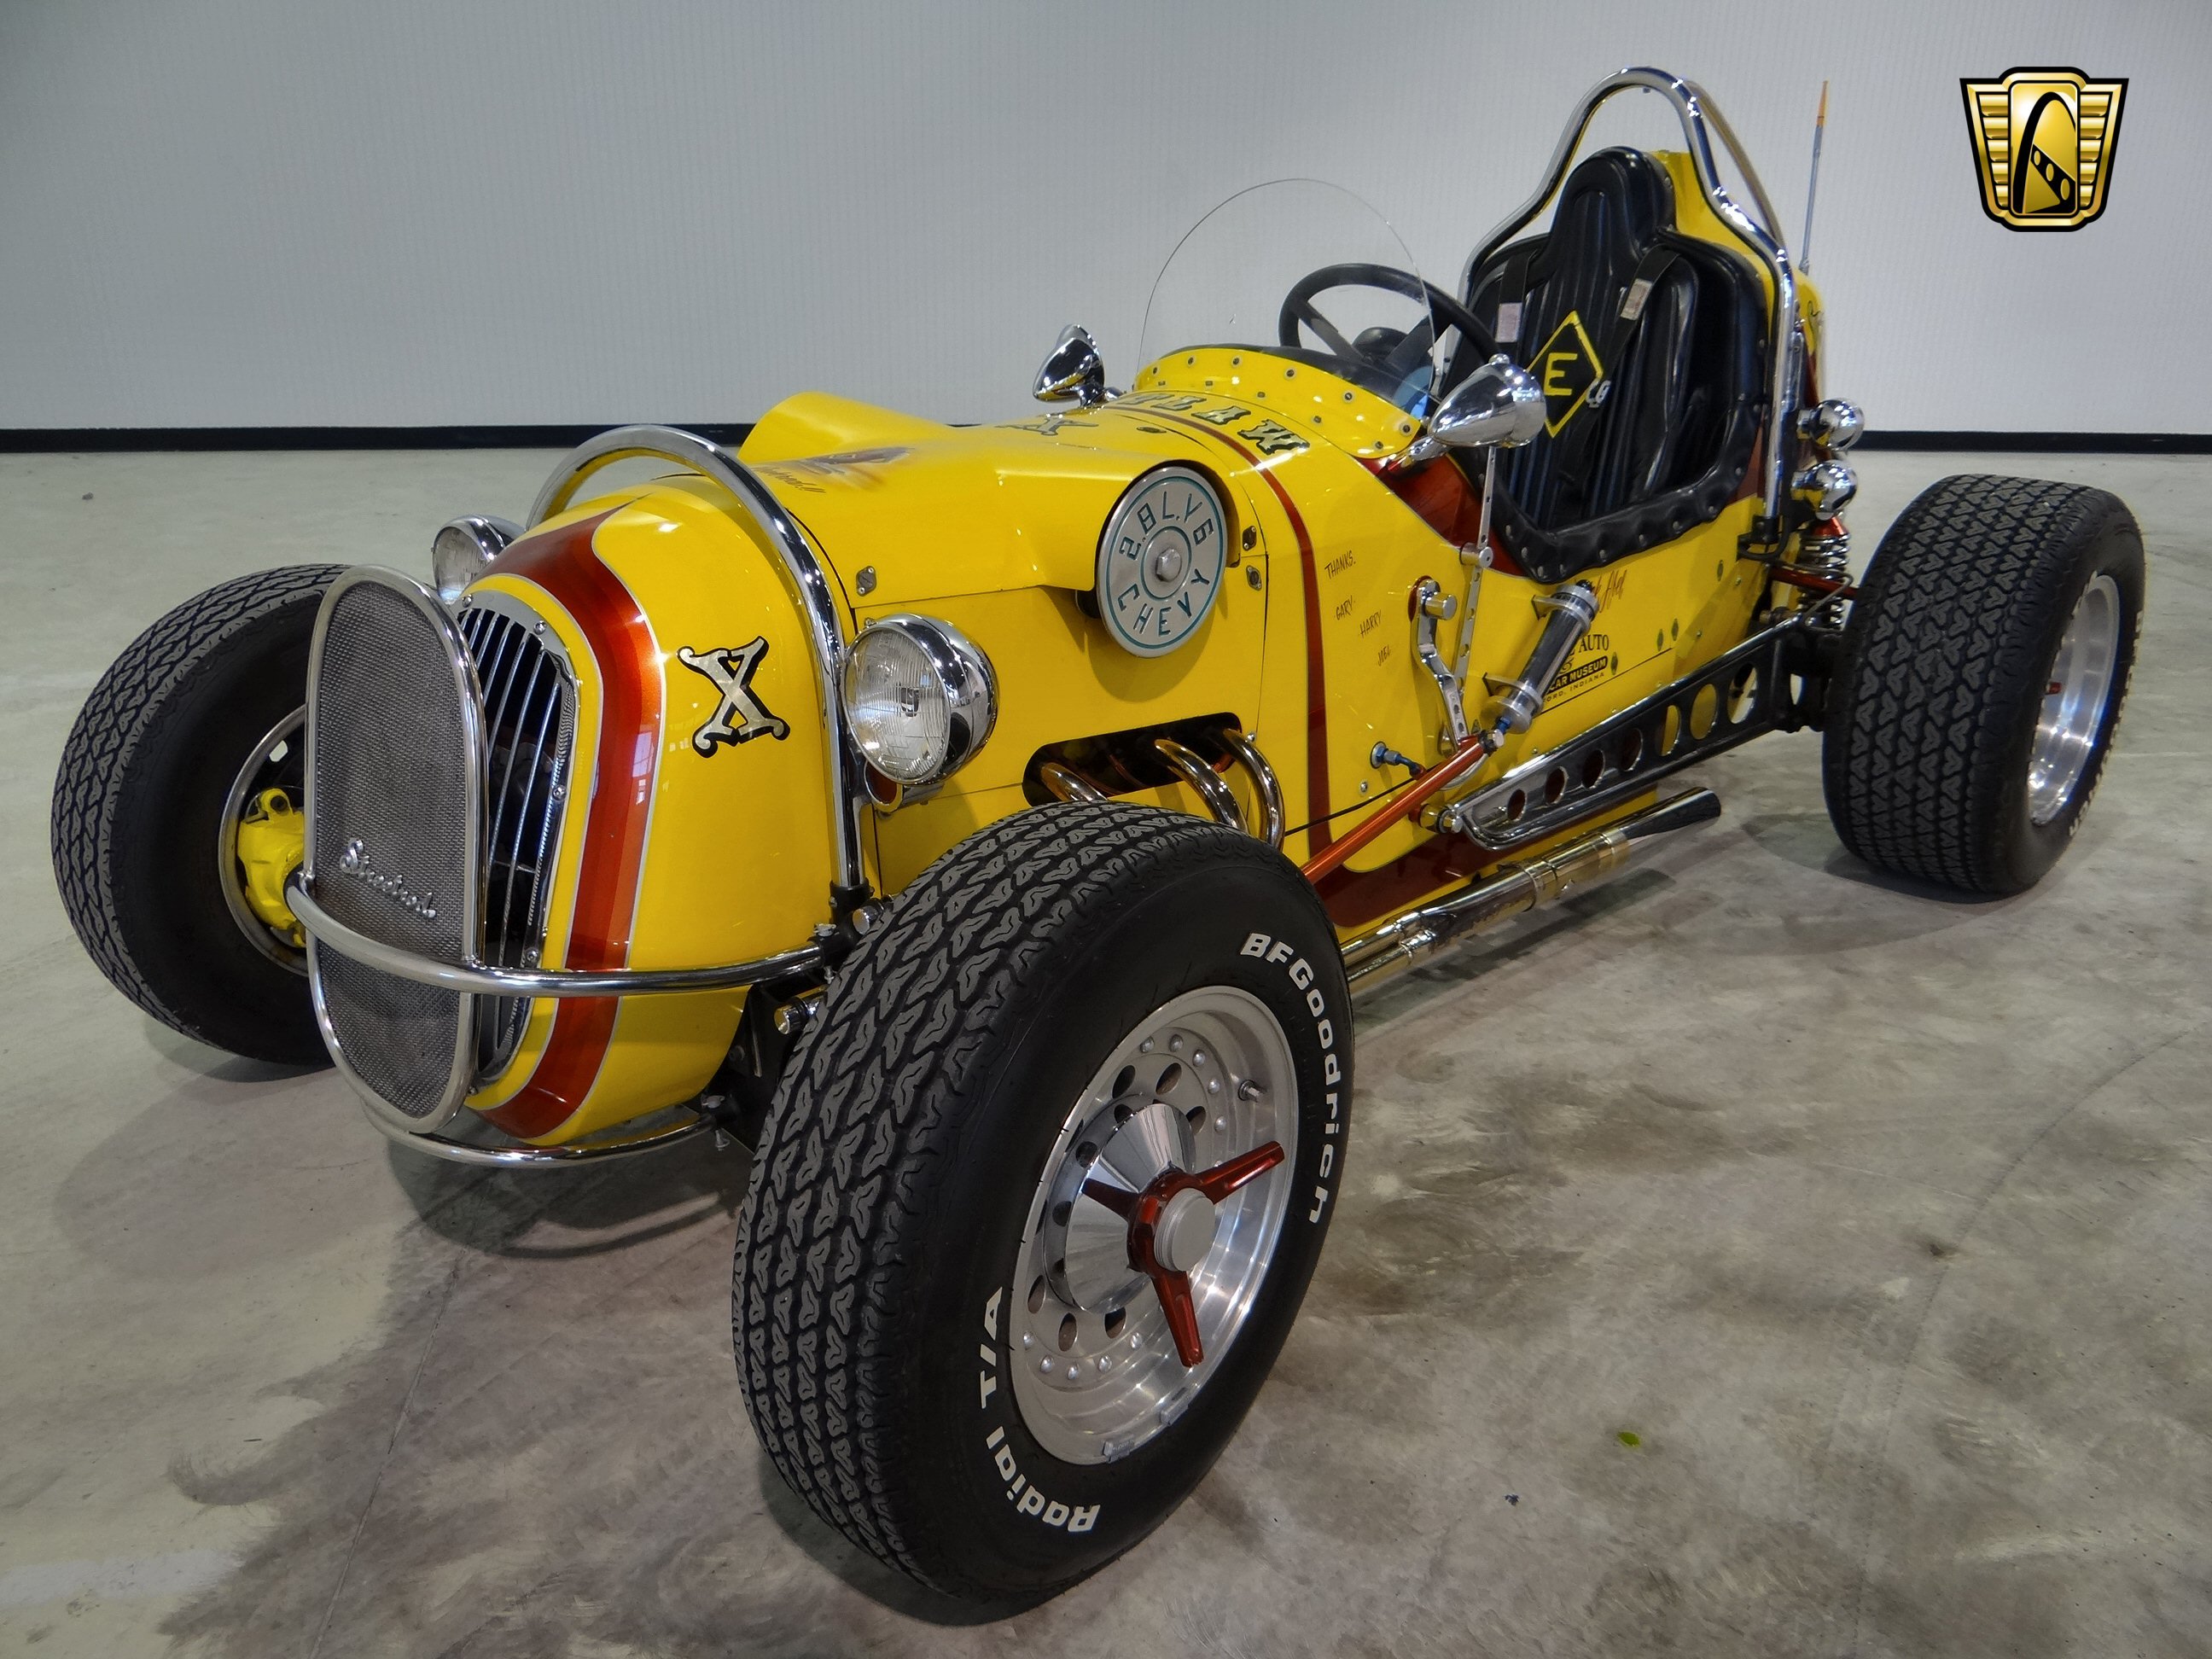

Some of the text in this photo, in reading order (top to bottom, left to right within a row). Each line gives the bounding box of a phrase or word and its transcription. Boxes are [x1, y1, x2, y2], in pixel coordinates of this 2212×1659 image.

[1543, 352, 1578, 396] E
[1116, 568, 1210, 637] CHEVY
[1569, 657, 1607, 683] MUSEUM
[1578, 633, 1610, 655] AUTO
[676, 635, 791, 759] X
[1569, 671, 1605, 692] INDIANA
[1239, 932, 1342, 1225] BFGoodrich
[980, 1286, 1102, 1533] Radial T/A
